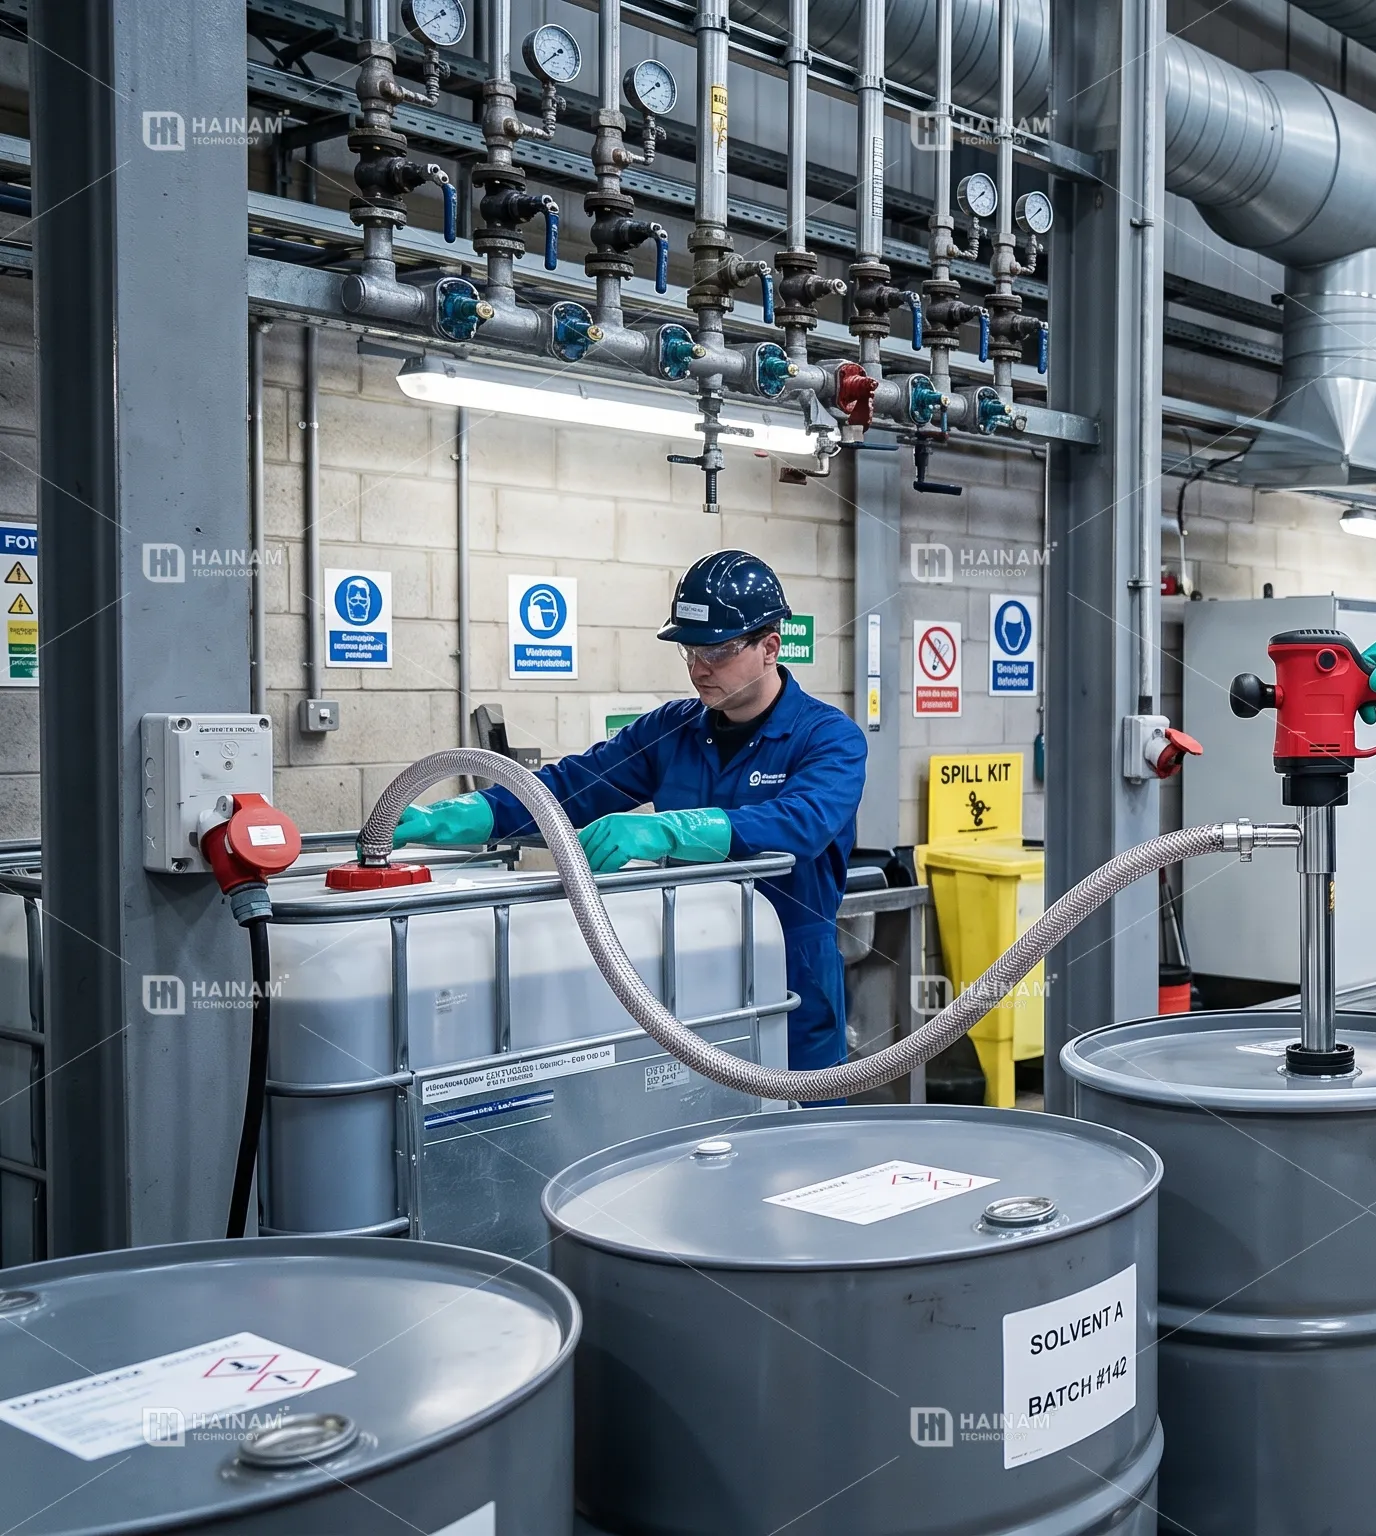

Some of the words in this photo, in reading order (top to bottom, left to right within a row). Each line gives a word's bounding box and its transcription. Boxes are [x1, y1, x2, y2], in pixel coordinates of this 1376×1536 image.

[940, 764, 982, 785] SPILL
[987, 763, 1011, 782] KIT
[1030, 1306, 1111, 1355] SOLVENT
[1114, 1301, 1124, 1323] A
[1028, 1374, 1092, 1418] BATCH
[1096, 1356, 1127, 1390] #142
